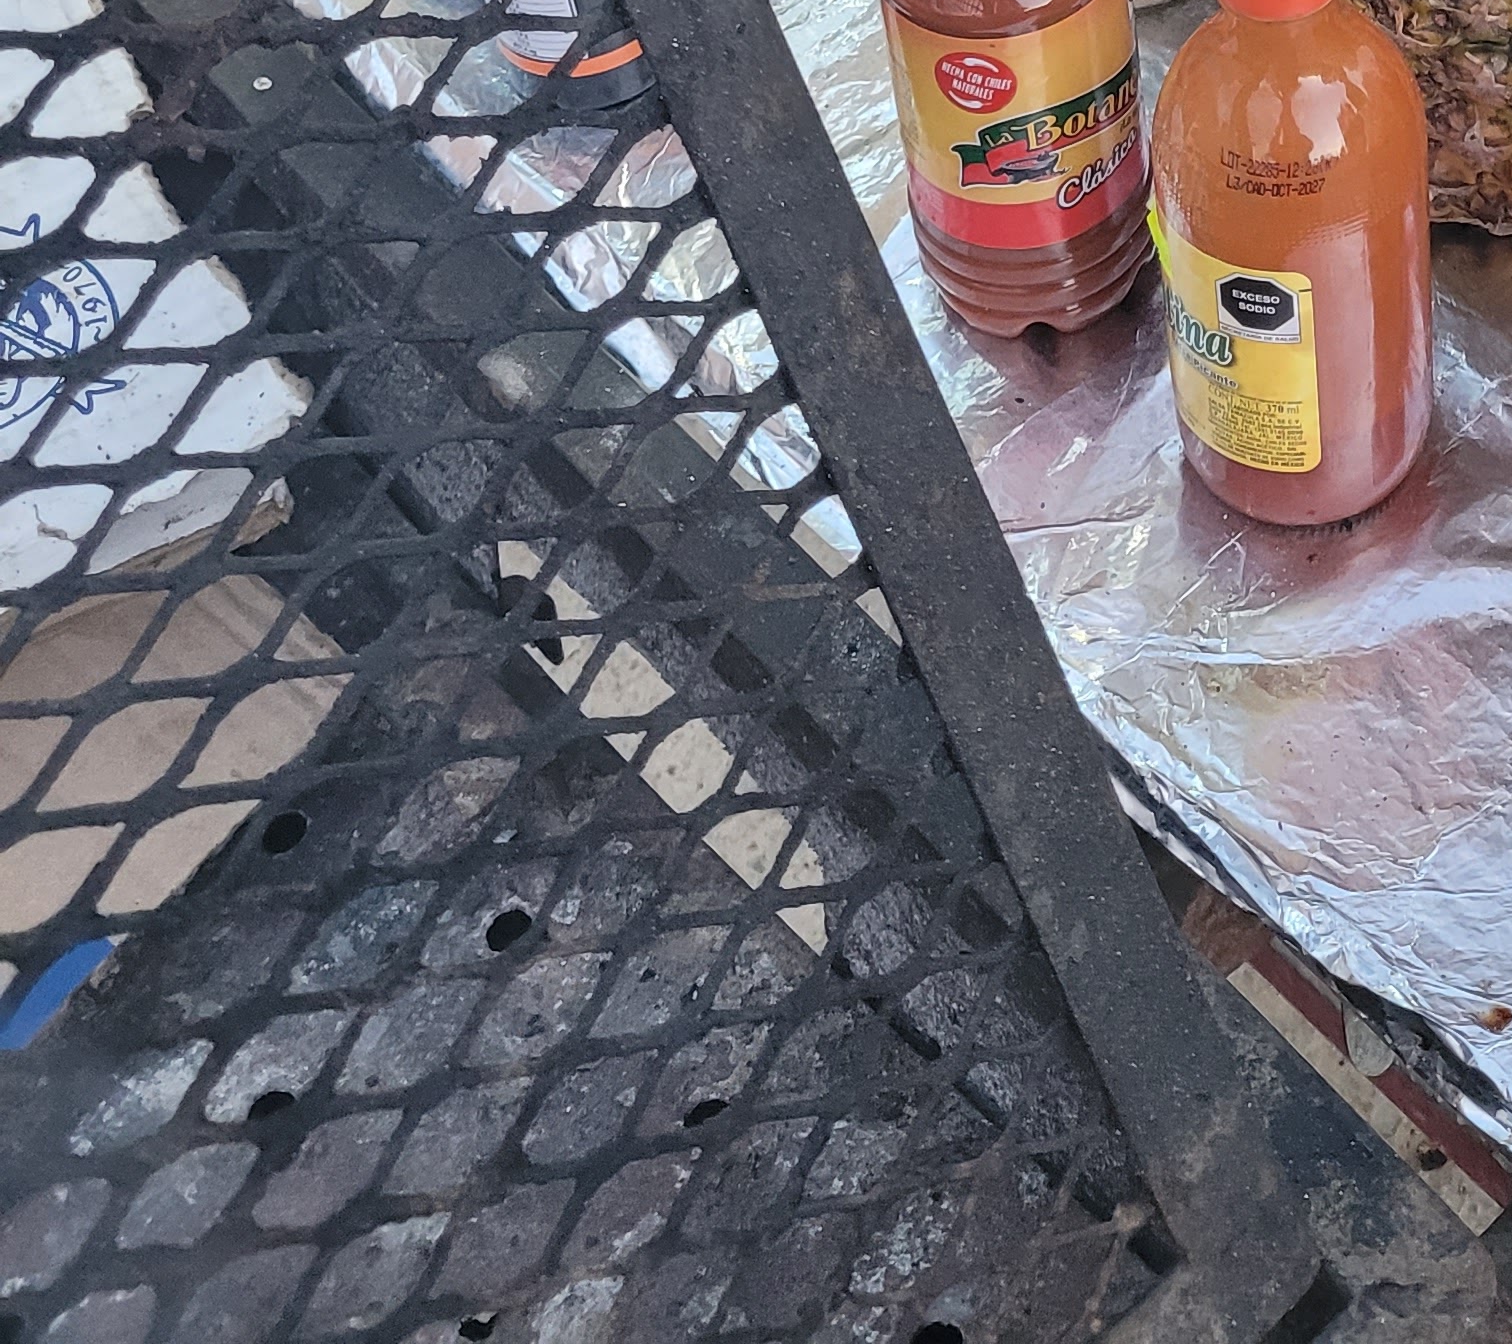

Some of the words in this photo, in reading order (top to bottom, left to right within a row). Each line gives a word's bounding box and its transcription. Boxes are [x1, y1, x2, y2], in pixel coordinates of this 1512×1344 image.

[941, 61, 965, 80] HECHA
[966, 71, 984, 85] CON
[983, 76, 1013, 91] CHILES
[951, 78, 995, 101] NATURALES
[1231, 288, 1280, 305] EXCESO
[1238, 301, 1276, 315] SODIO
